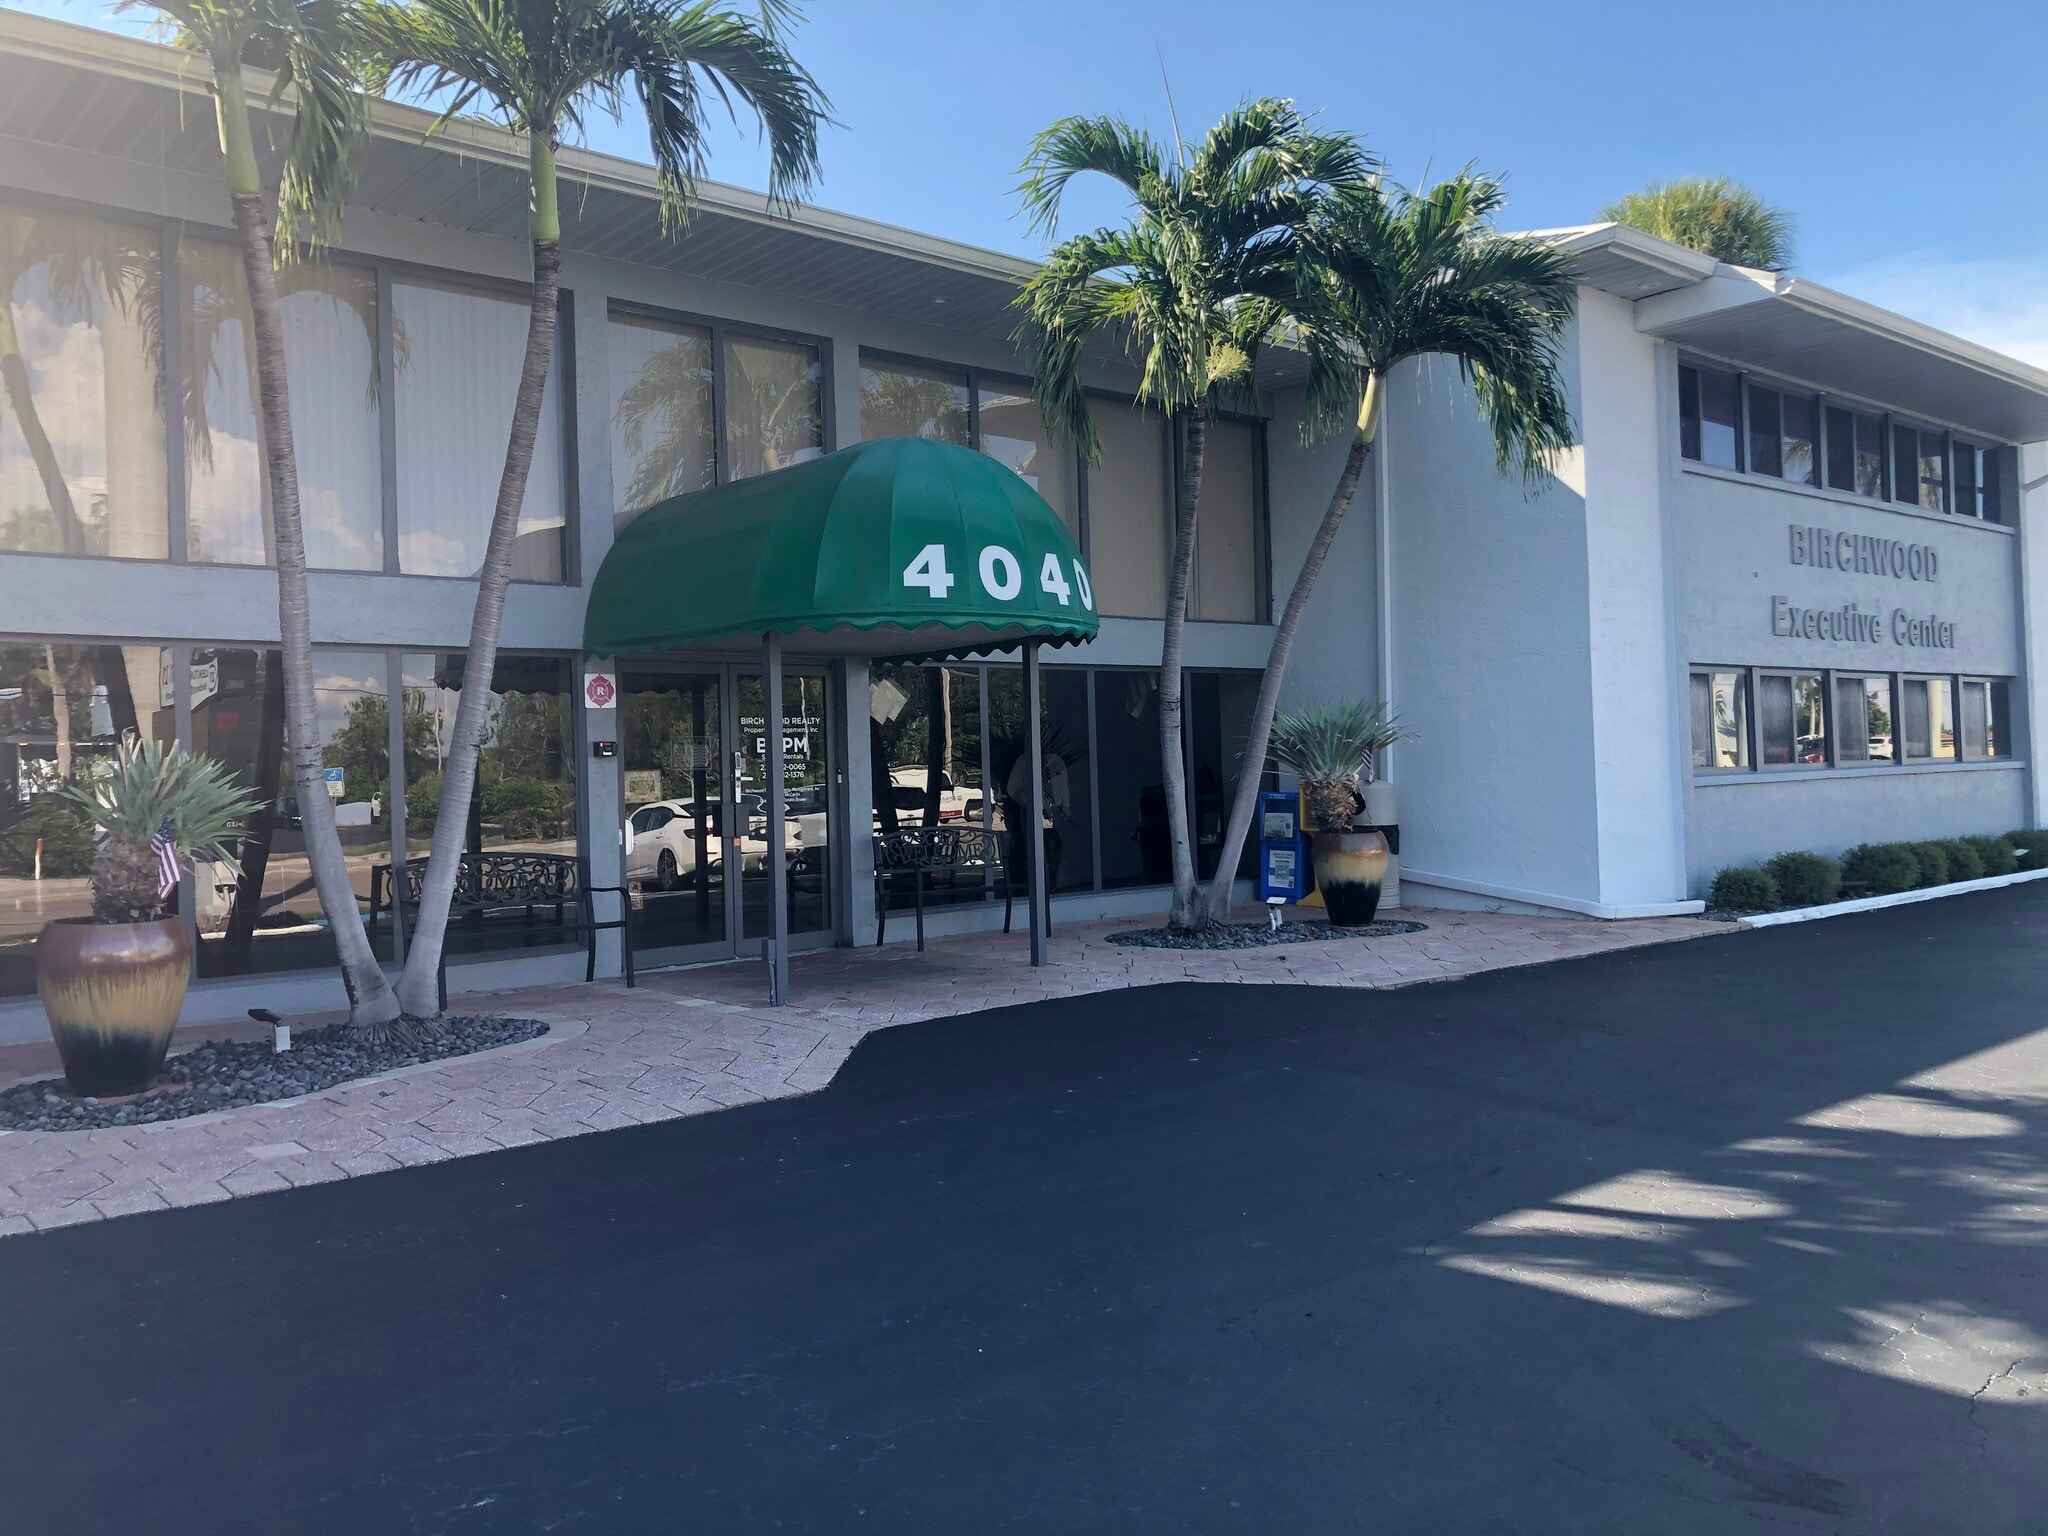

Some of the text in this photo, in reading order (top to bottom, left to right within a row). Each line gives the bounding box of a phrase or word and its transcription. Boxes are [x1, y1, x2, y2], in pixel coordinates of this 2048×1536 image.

[1789, 524, 1938, 581] BIRCHWOOD
[903, 543, 1092, 611] 4040
[1771, 595, 1957, 649] Executive Center
[597, 686, 604, 695] R
[740, 717, 821, 725] BIRCHD REALTY
[756, 737, 808, 753] BPM
